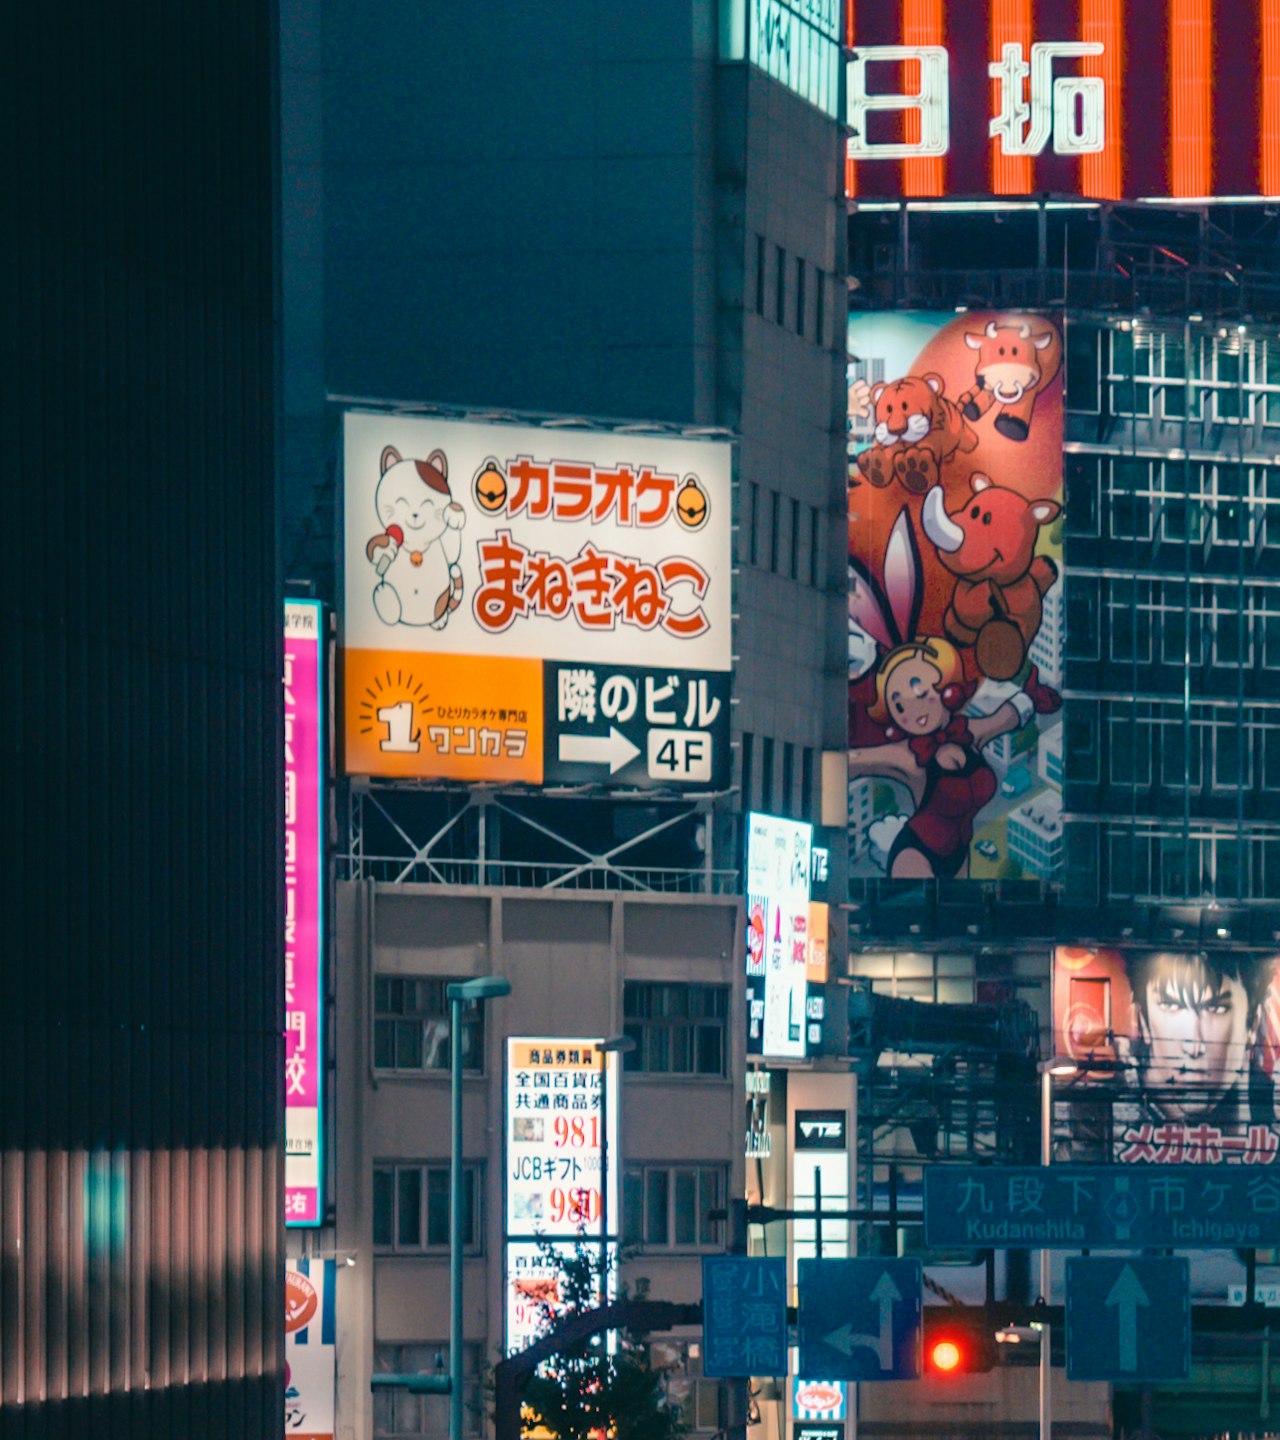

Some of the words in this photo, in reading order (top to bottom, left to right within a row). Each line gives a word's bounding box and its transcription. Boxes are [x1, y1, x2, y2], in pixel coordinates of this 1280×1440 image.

[846, 42, 1105, 159] 日拓
[507, 456, 677, 527] カラオケ
[473, 530, 711, 638] まねきねこ
[436, 704, 528, 724] ひとりカラオケ専門店
[557, 669, 721, 728] 隣のビル
[428, 725, 529, 758] ワンカラ
[655, 739, 706, 774] 4F
[514, 1071, 602, 1089] 全国百貨店
[513, 1157, 582, 1181] JCBギフト
[956, 1175, 1096, 1214] 九段下
[1115, 1198, 1129, 1217] 4
[966, 1219, 1085, 1241] Kudanshita
[1172, 1219, 1261, 1245] Ichigaya
[741, 1265, 781, 1369] 小滝橋
